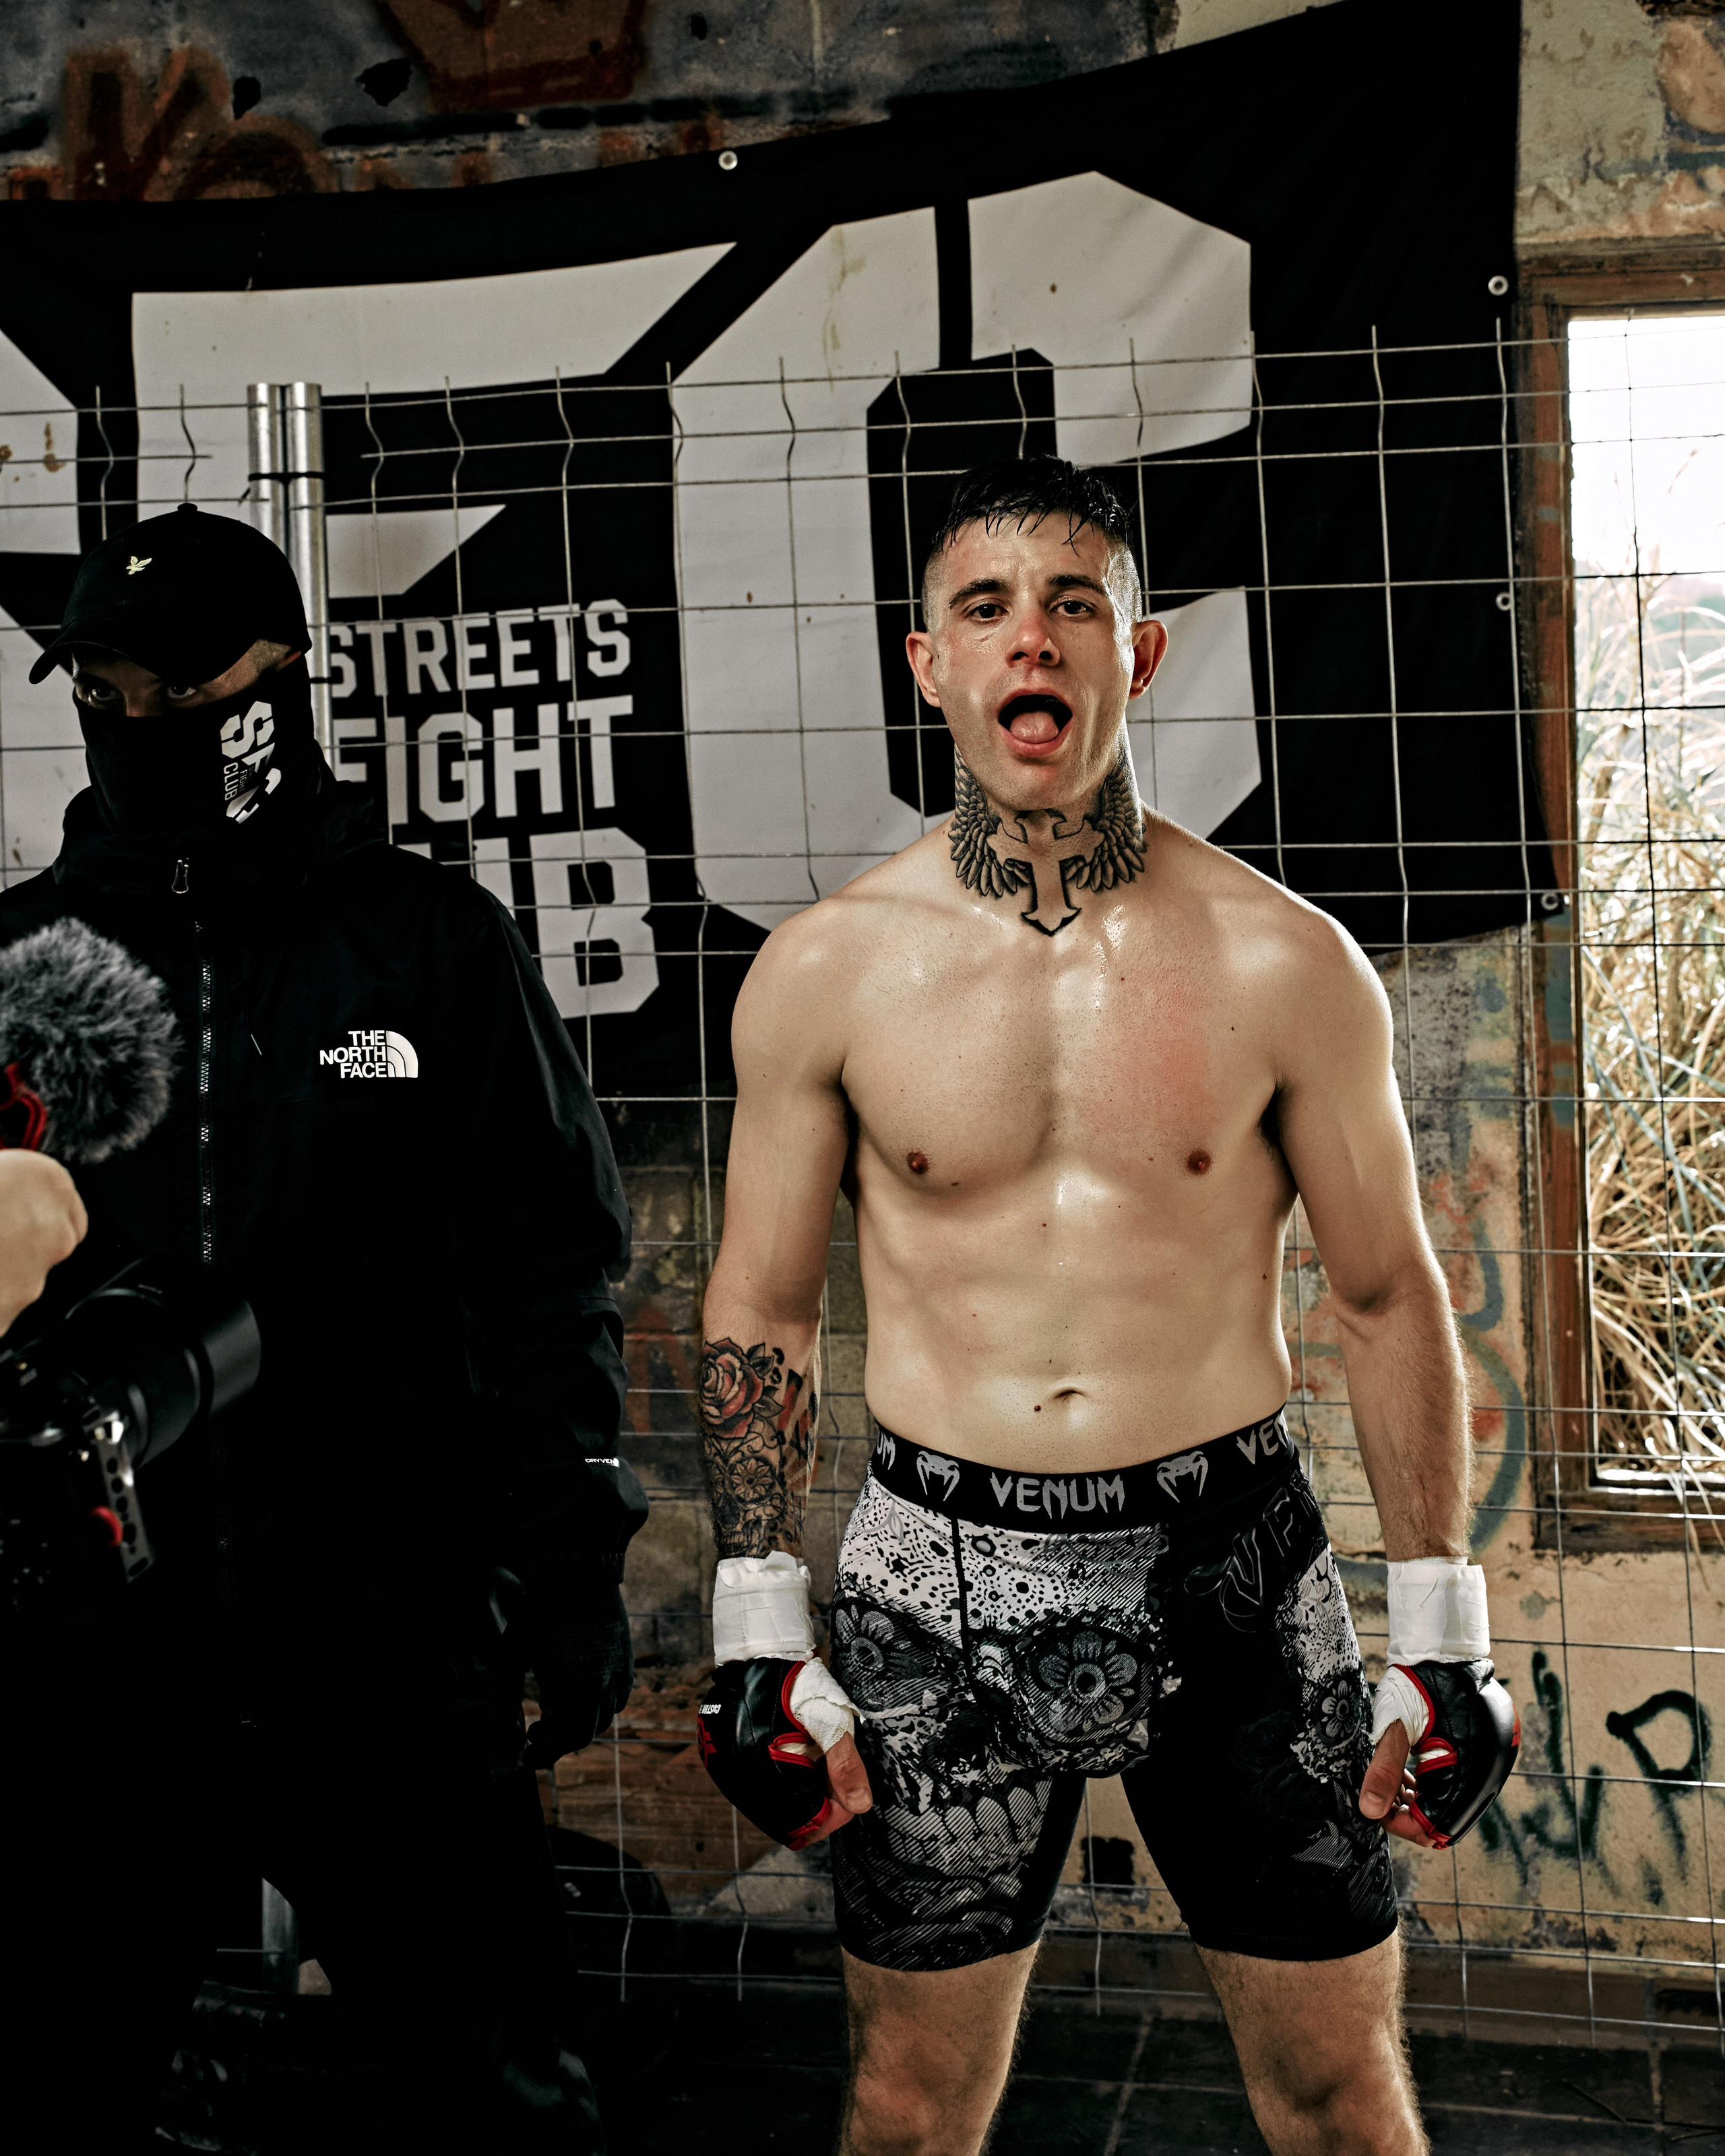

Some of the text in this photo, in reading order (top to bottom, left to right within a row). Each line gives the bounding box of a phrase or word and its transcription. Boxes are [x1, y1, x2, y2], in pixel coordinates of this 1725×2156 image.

[329, 599, 631, 697] STREETS
[223, 761, 239, 801] CLUB
[332, 695, 633, 825] FIGHT
[319, 1046, 387, 1065] NORTH
[348, 1029, 386, 1046] THE
[340, 1062, 387, 1079] FACE
[1236, 1413, 1294, 1465] VEN
[989, 1473, 1125, 1520] VENUM
